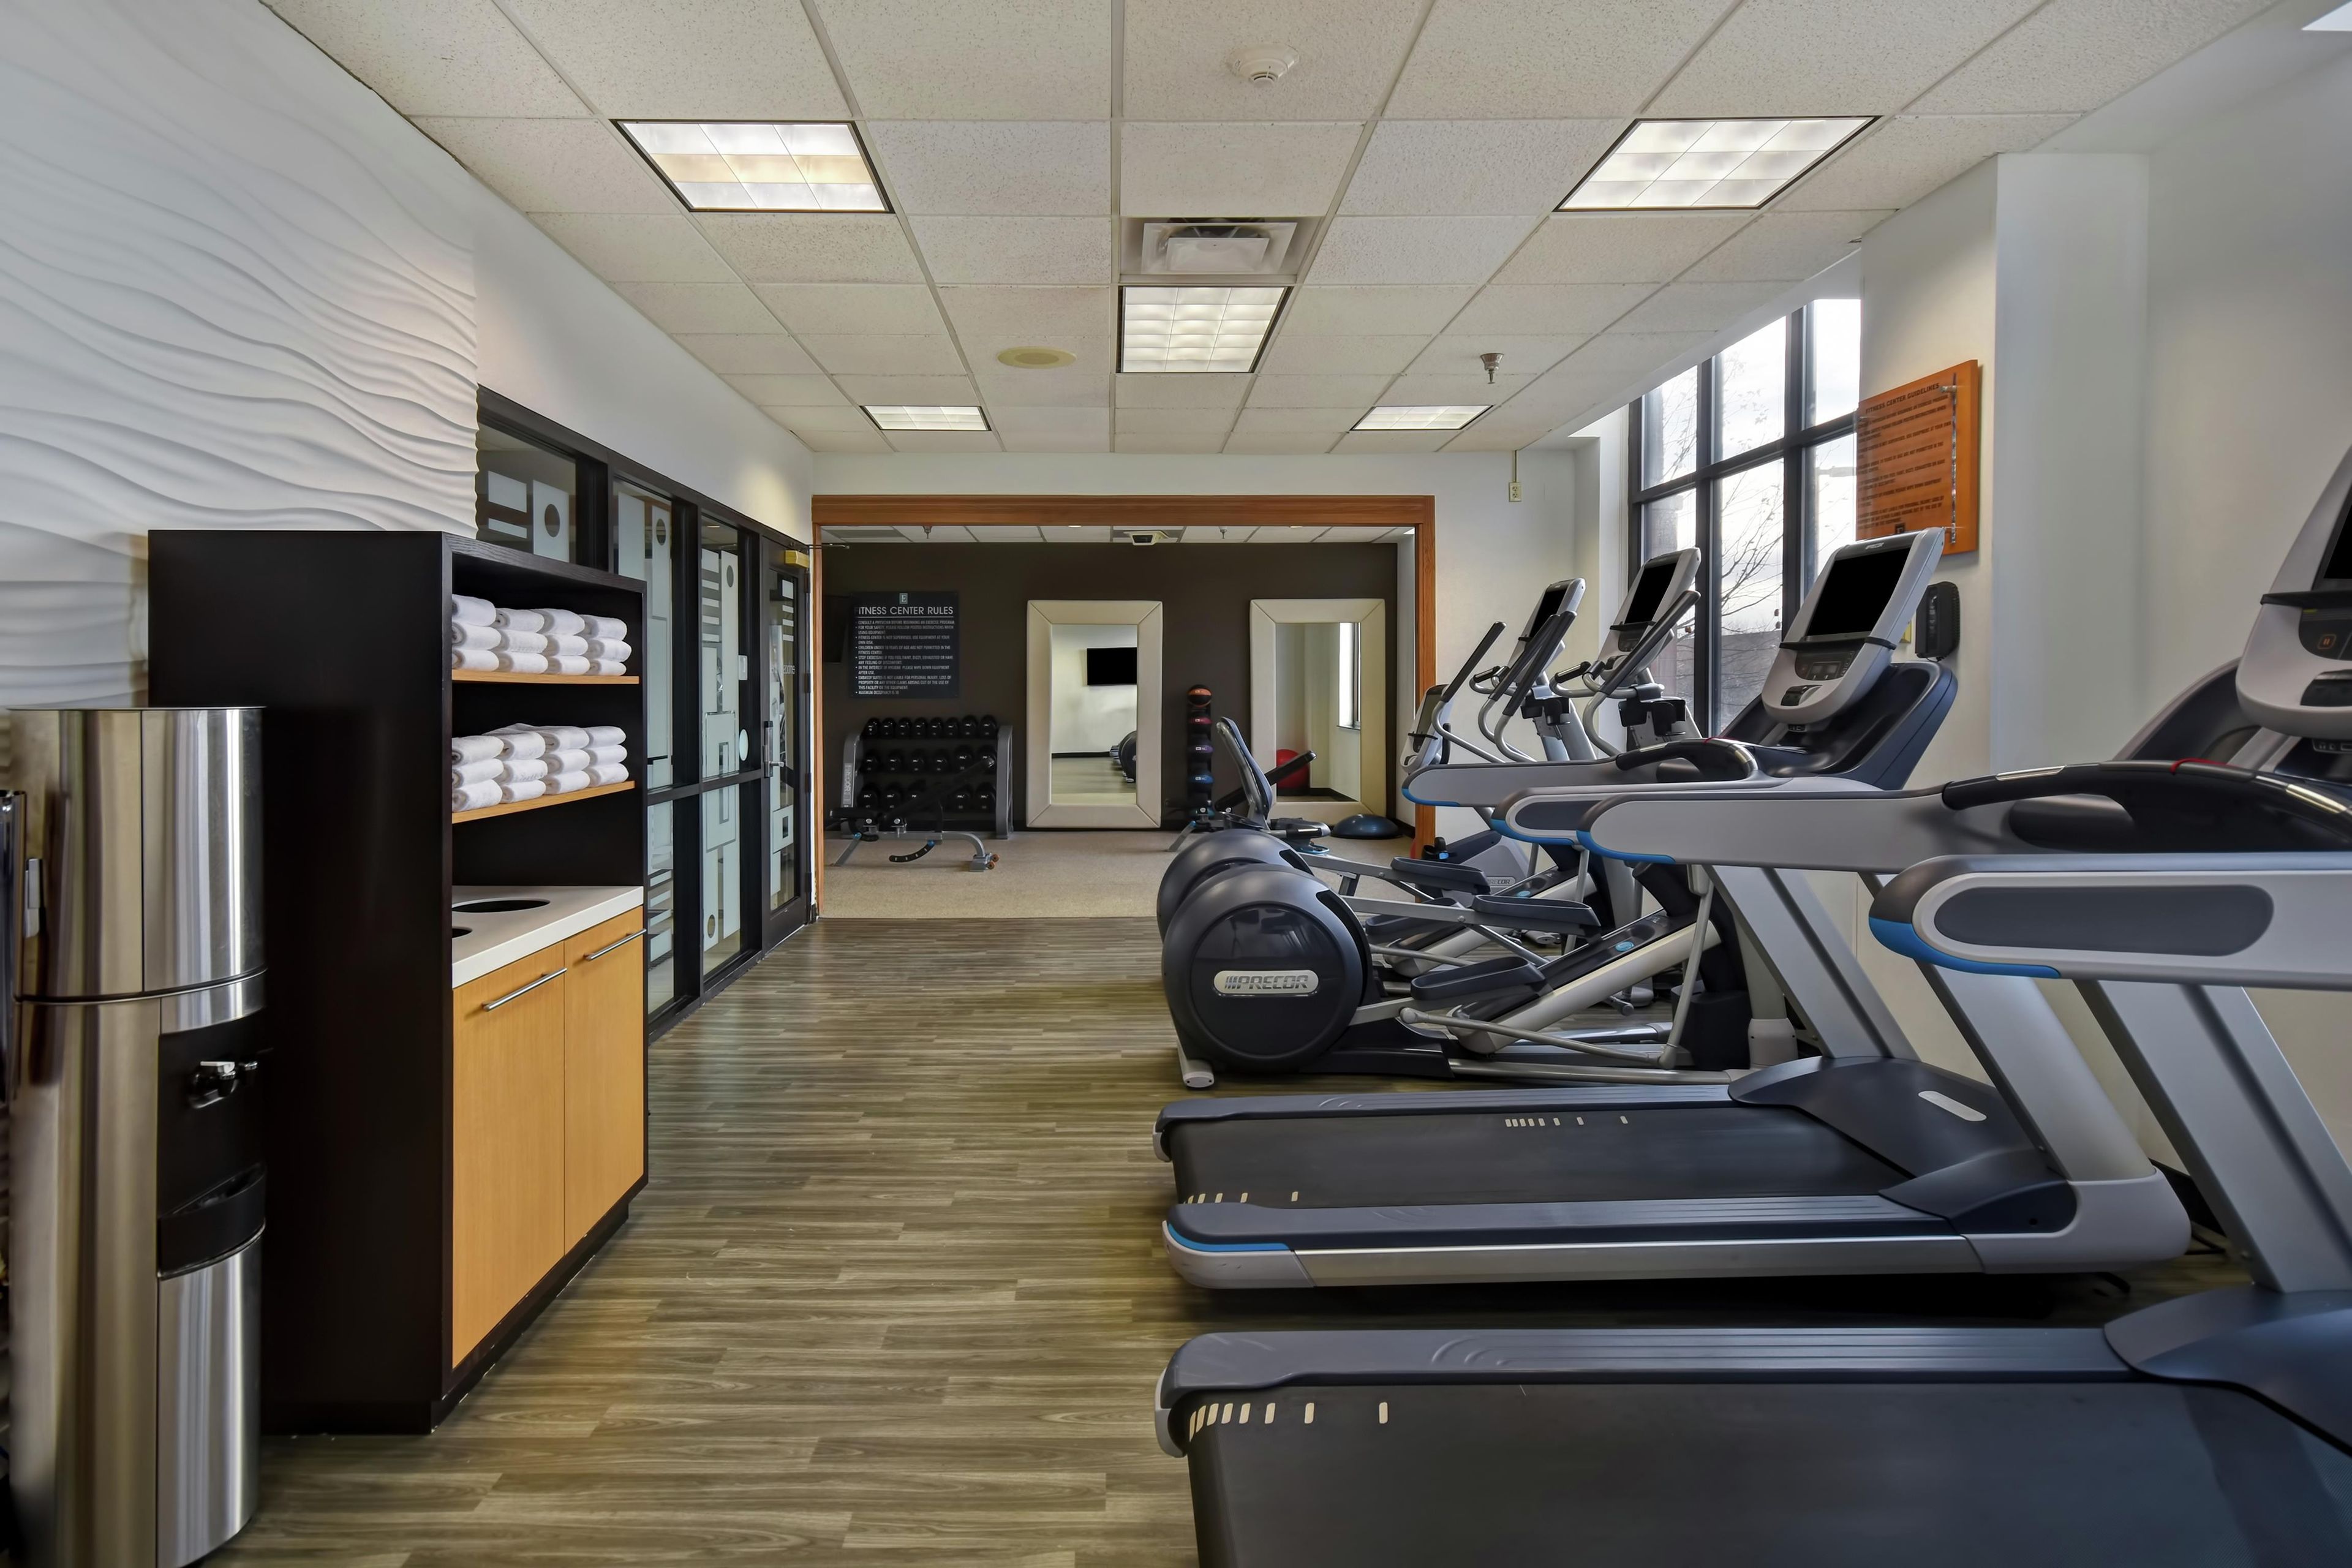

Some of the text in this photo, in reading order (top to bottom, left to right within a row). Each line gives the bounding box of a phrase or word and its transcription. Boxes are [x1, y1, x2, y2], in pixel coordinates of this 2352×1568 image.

[1866, 382, 1940, 414] FITNESS CENTER GUIDELINES
[889, 606, 924, 615] CENTER
[927, 606, 954, 615] RULES
[1225, 974, 1308, 990] PRECOR
